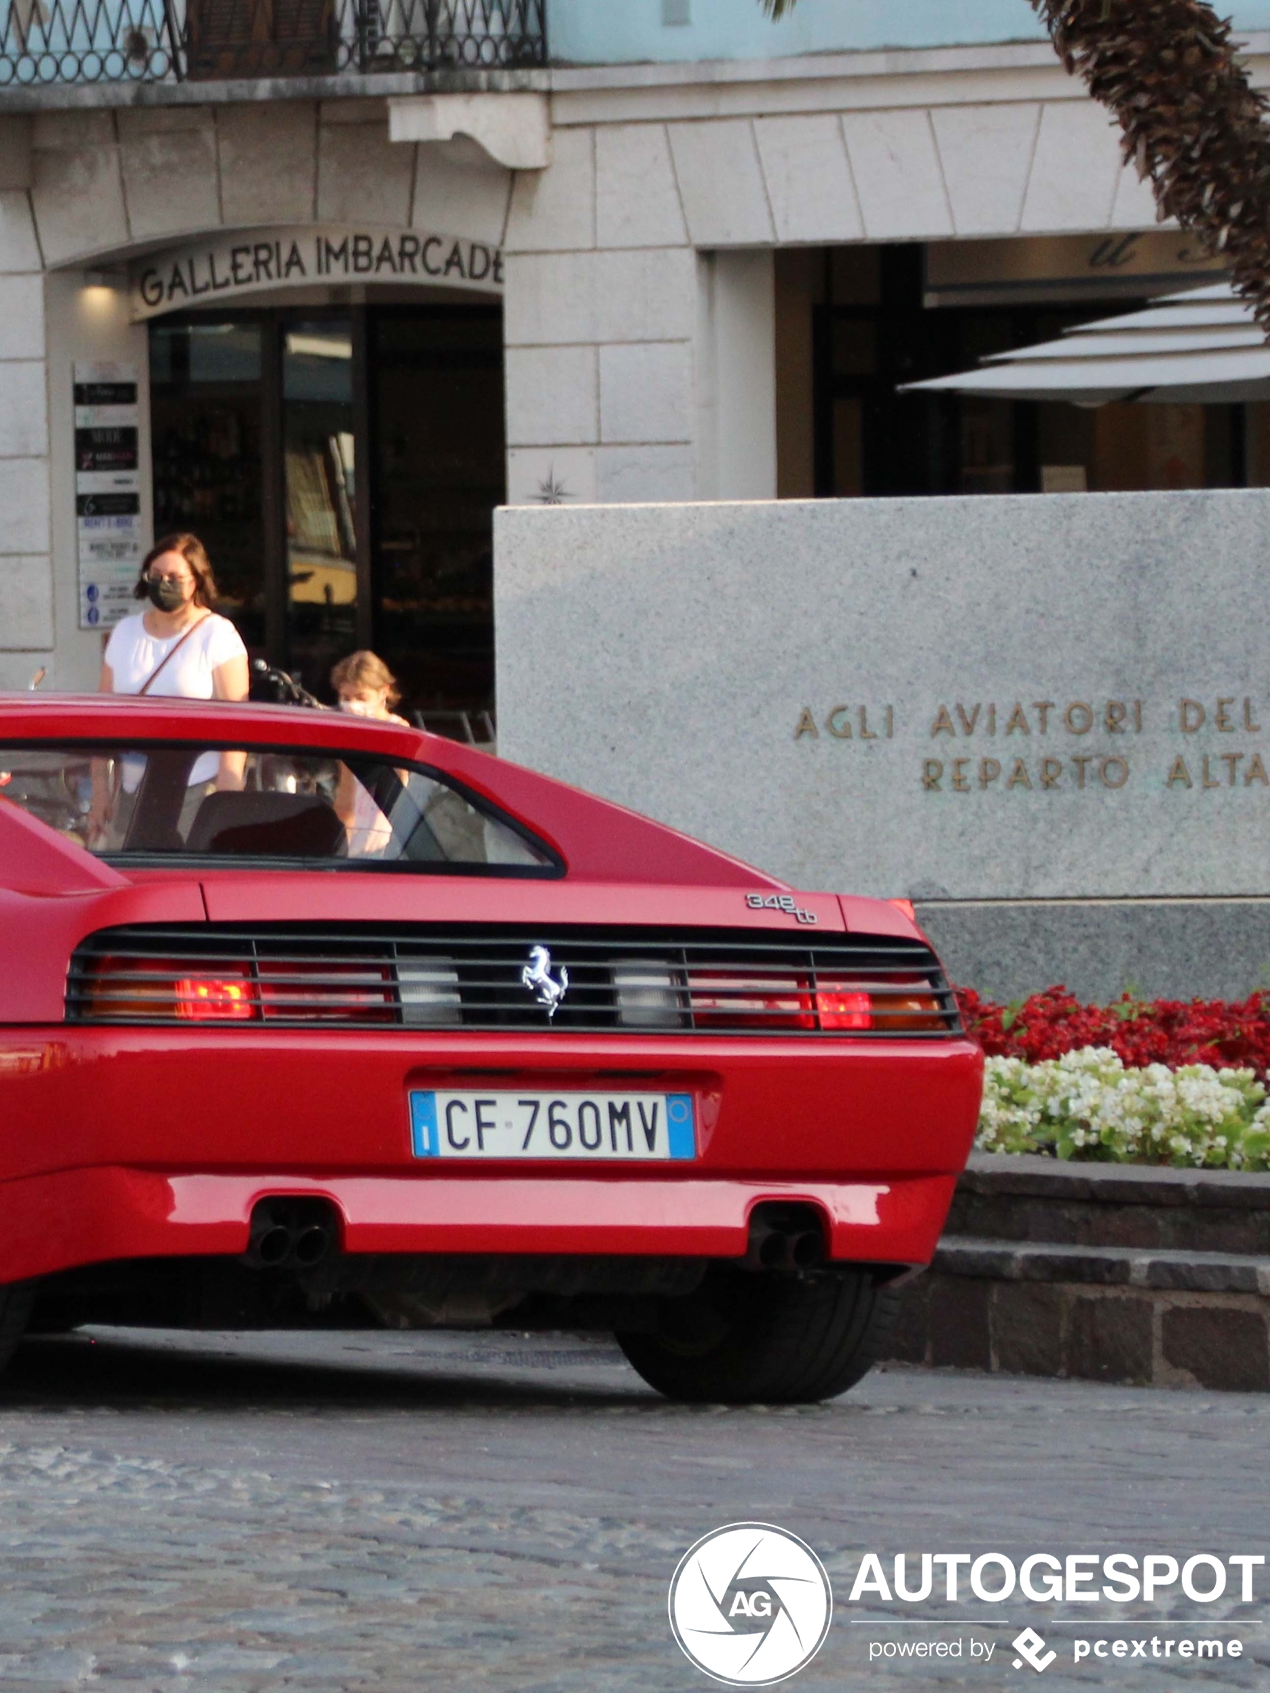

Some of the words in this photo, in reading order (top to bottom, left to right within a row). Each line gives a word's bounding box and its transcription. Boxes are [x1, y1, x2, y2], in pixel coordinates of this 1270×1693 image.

[140, 241, 306, 306] GALLERIA
[793, 705, 894, 740] AGLI
[931, 701, 1142, 737] AVIATORI
[921, 755, 1129, 792] REPARTO
[1166, 752, 1270, 789] ALTA
[745, 893, 795, 910] 348
